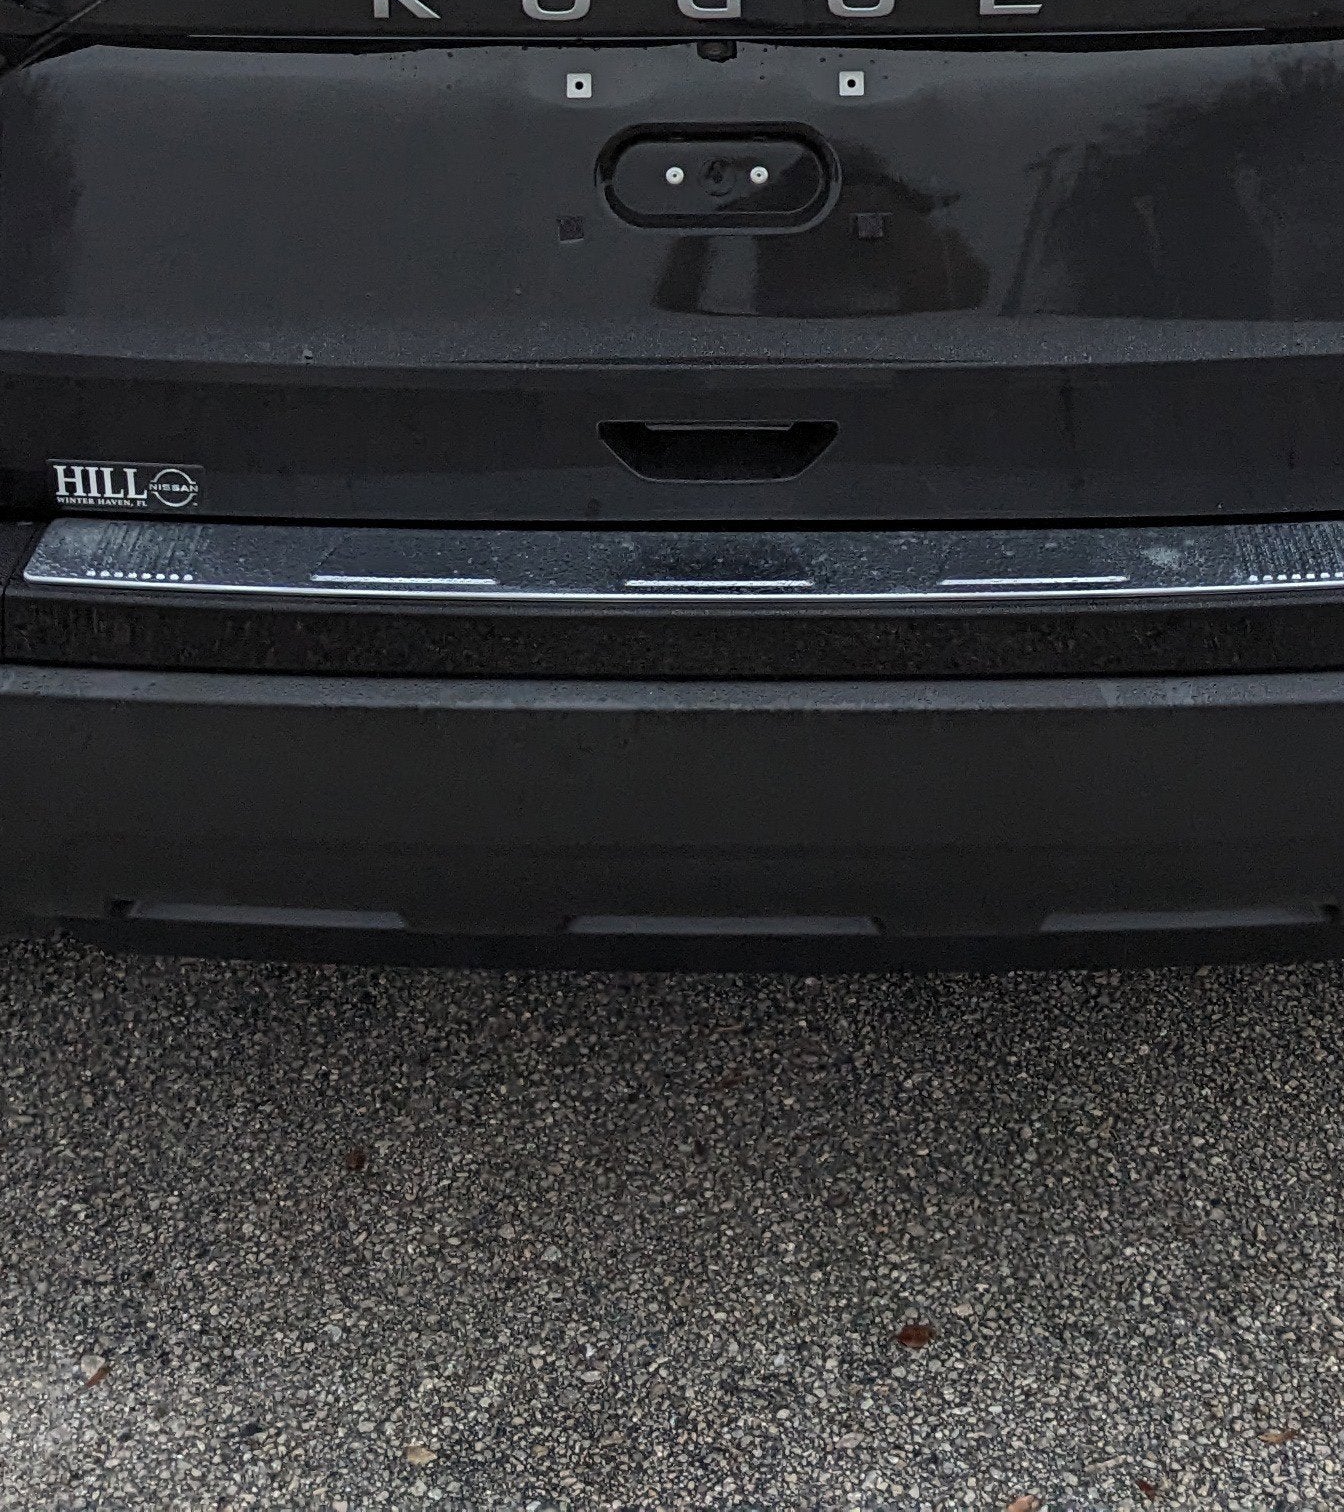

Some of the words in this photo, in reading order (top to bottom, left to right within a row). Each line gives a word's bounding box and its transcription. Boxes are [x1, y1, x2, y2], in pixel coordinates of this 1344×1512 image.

[53, 464, 148, 499] HILL
[149, 483, 199, 493] NISSAN
[57, 496, 95, 505] WINTER
